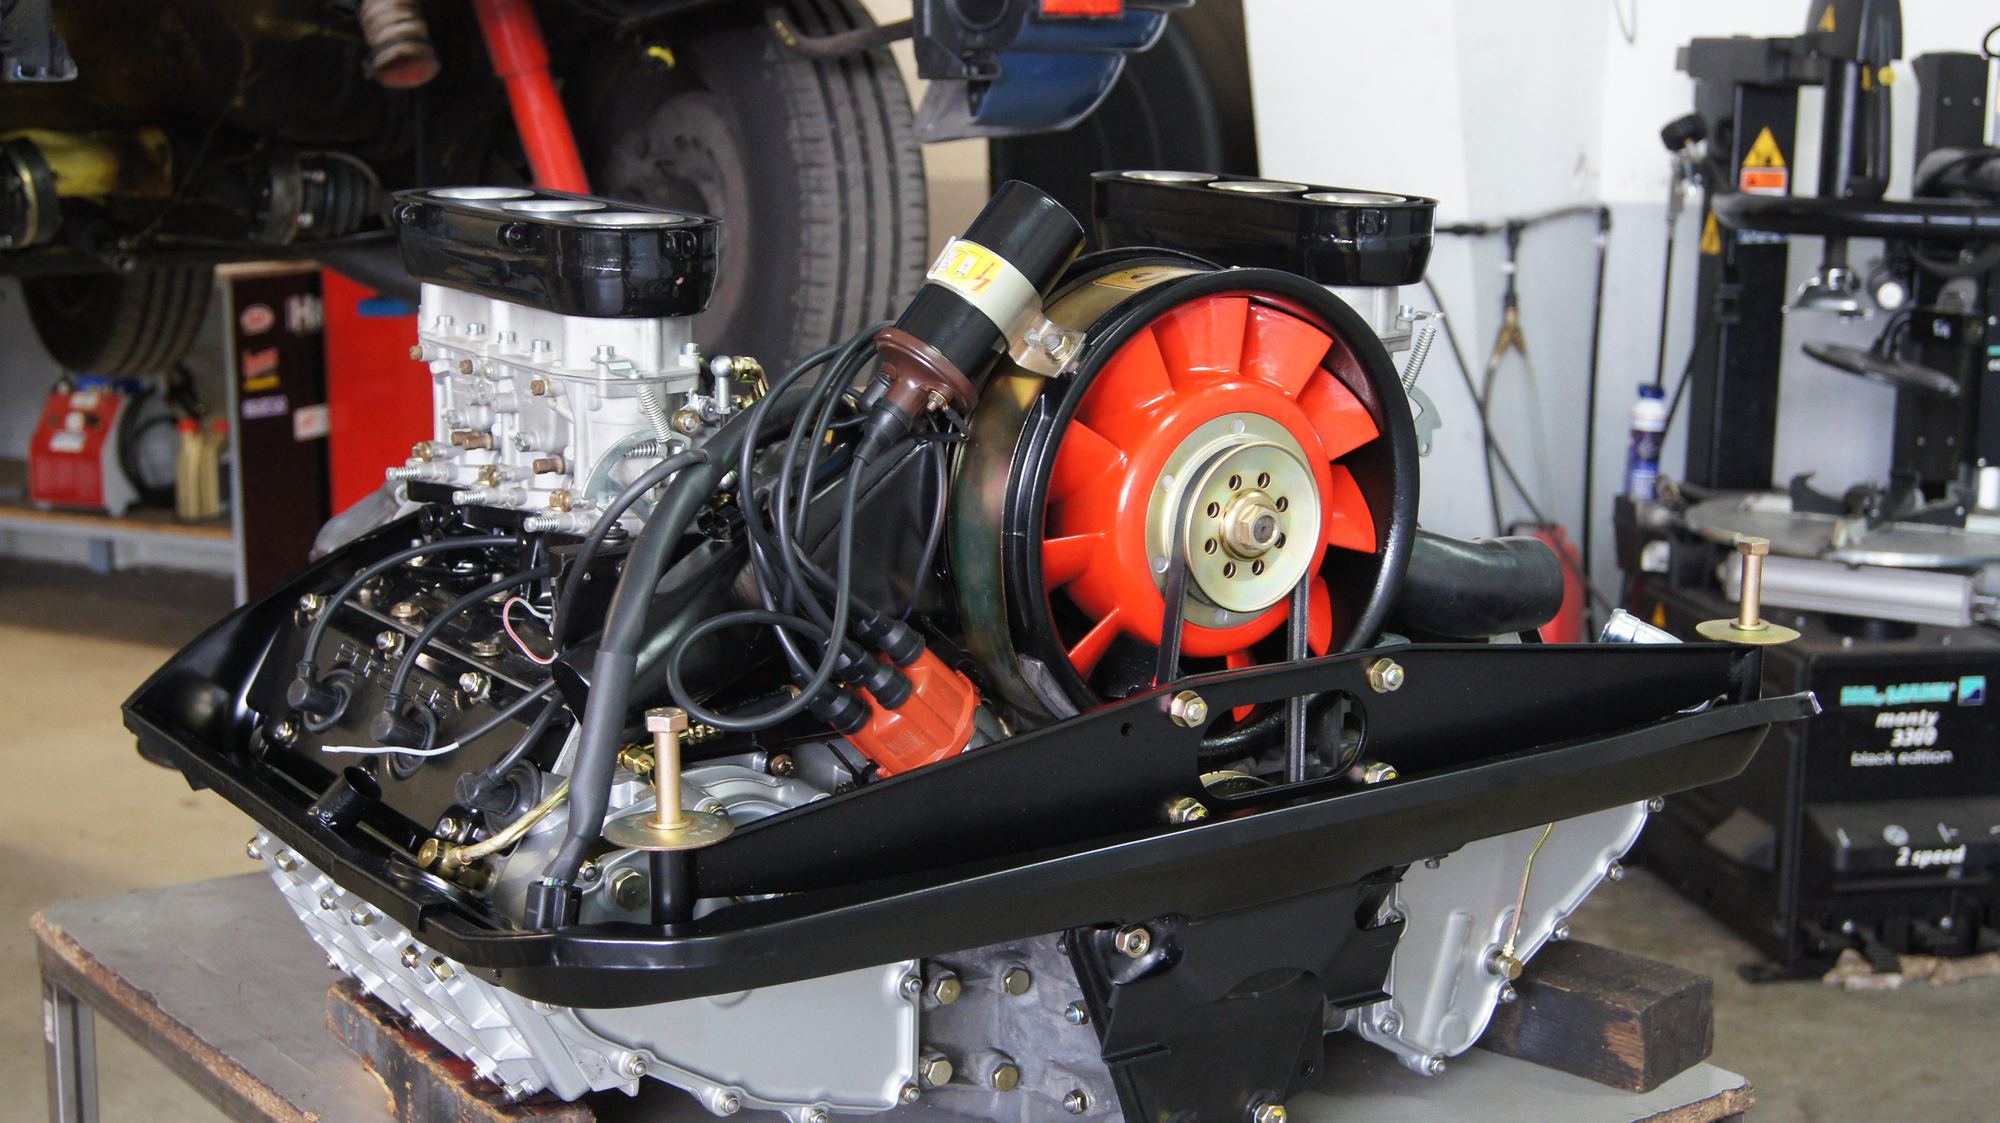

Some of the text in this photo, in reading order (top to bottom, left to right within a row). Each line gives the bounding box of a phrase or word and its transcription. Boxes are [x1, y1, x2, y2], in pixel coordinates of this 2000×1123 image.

[1875, 709, 1940, 728] monty
[1850, 749, 1954, 767] black edition
[1895, 844, 1967, 870] 2 speed
